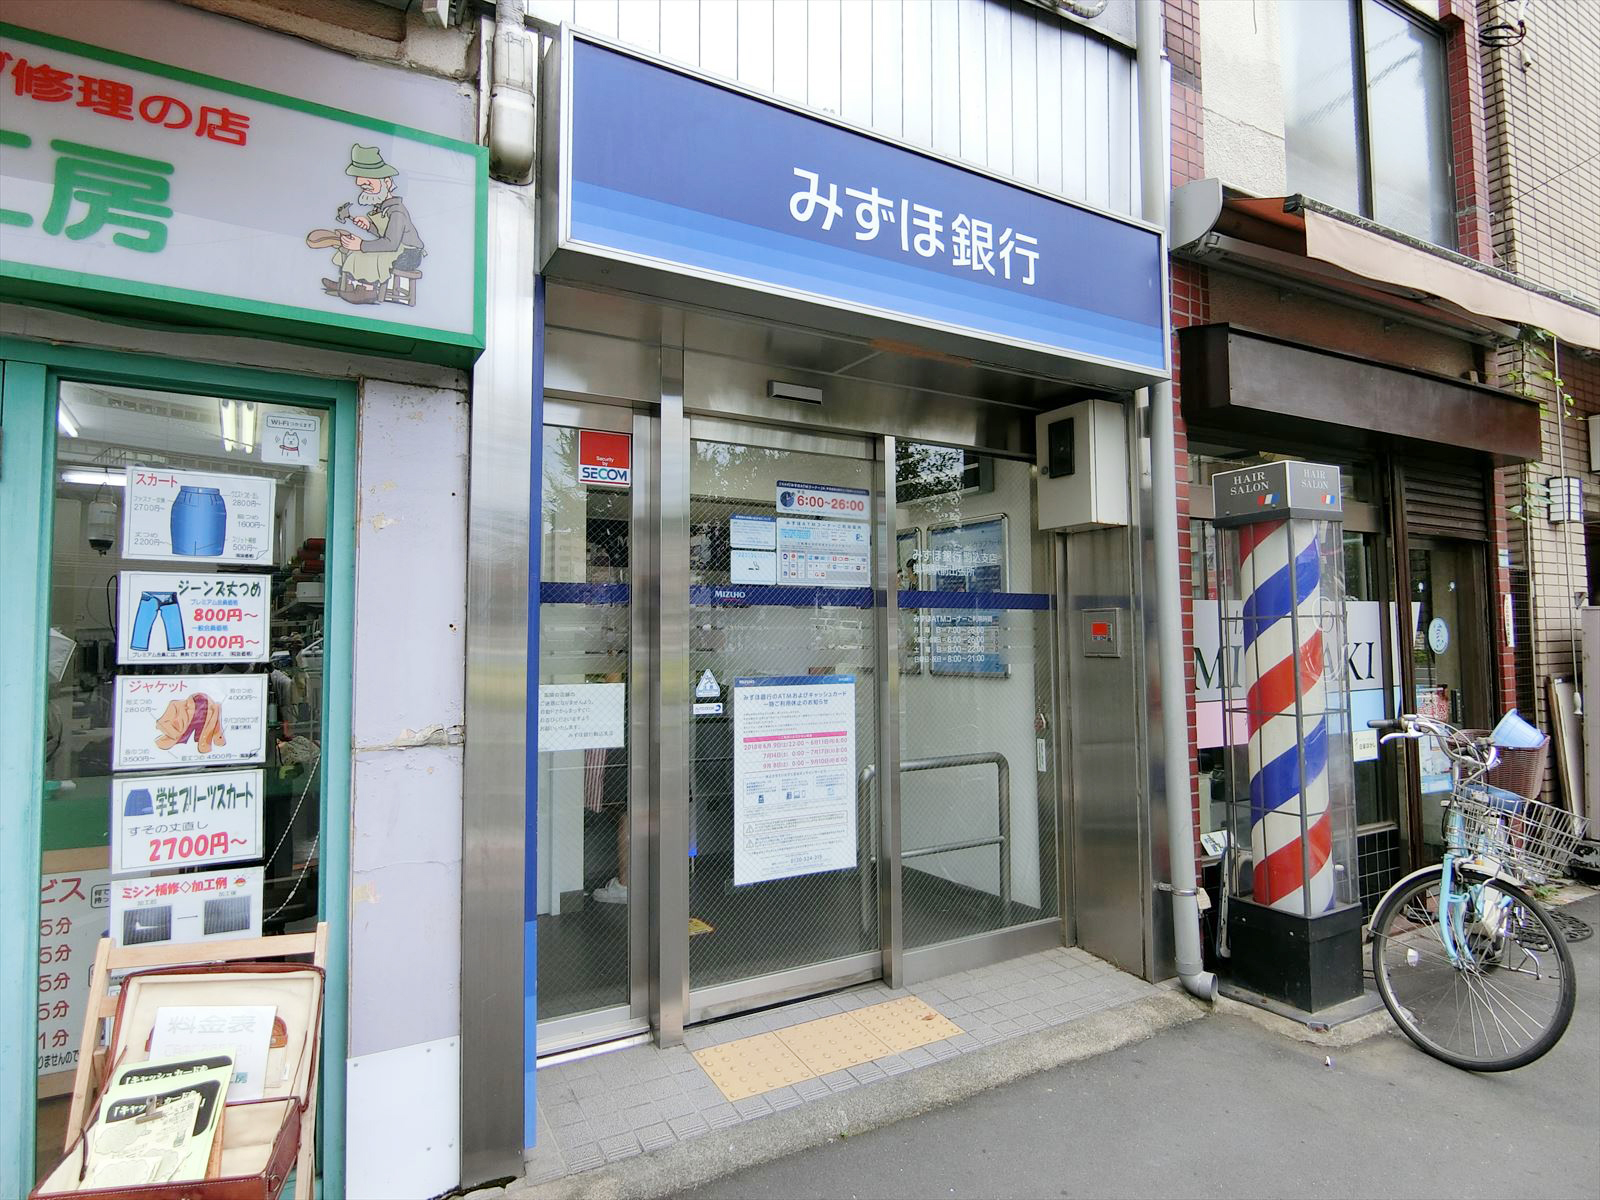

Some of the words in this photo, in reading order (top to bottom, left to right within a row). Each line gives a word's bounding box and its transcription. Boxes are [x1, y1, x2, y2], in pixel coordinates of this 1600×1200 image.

[789, 167, 1041, 286] みずほ銀行
[136, 473, 178, 488] スカート
[582, 467, 627, 481] SECOM
[1234, 471, 1265, 485] HAIR
[1303, 469, 1327, 479] HAIR
[1230, 481, 1269, 496] SALON
[1301, 479, 1330, 490] SALON
[912, 549, 961, 563] みずほ銀行
[178, 580, 261, 597] ジーンズ丈つめ
[714, 590, 746, 599] MIZUHO
[129, 680, 188, 693] ジャケット
[156, 782, 253, 817] 学生プリーツスカート
[128, 821, 209, 836] すその丈直し
[167, 1015, 257, 1034] 料金表
